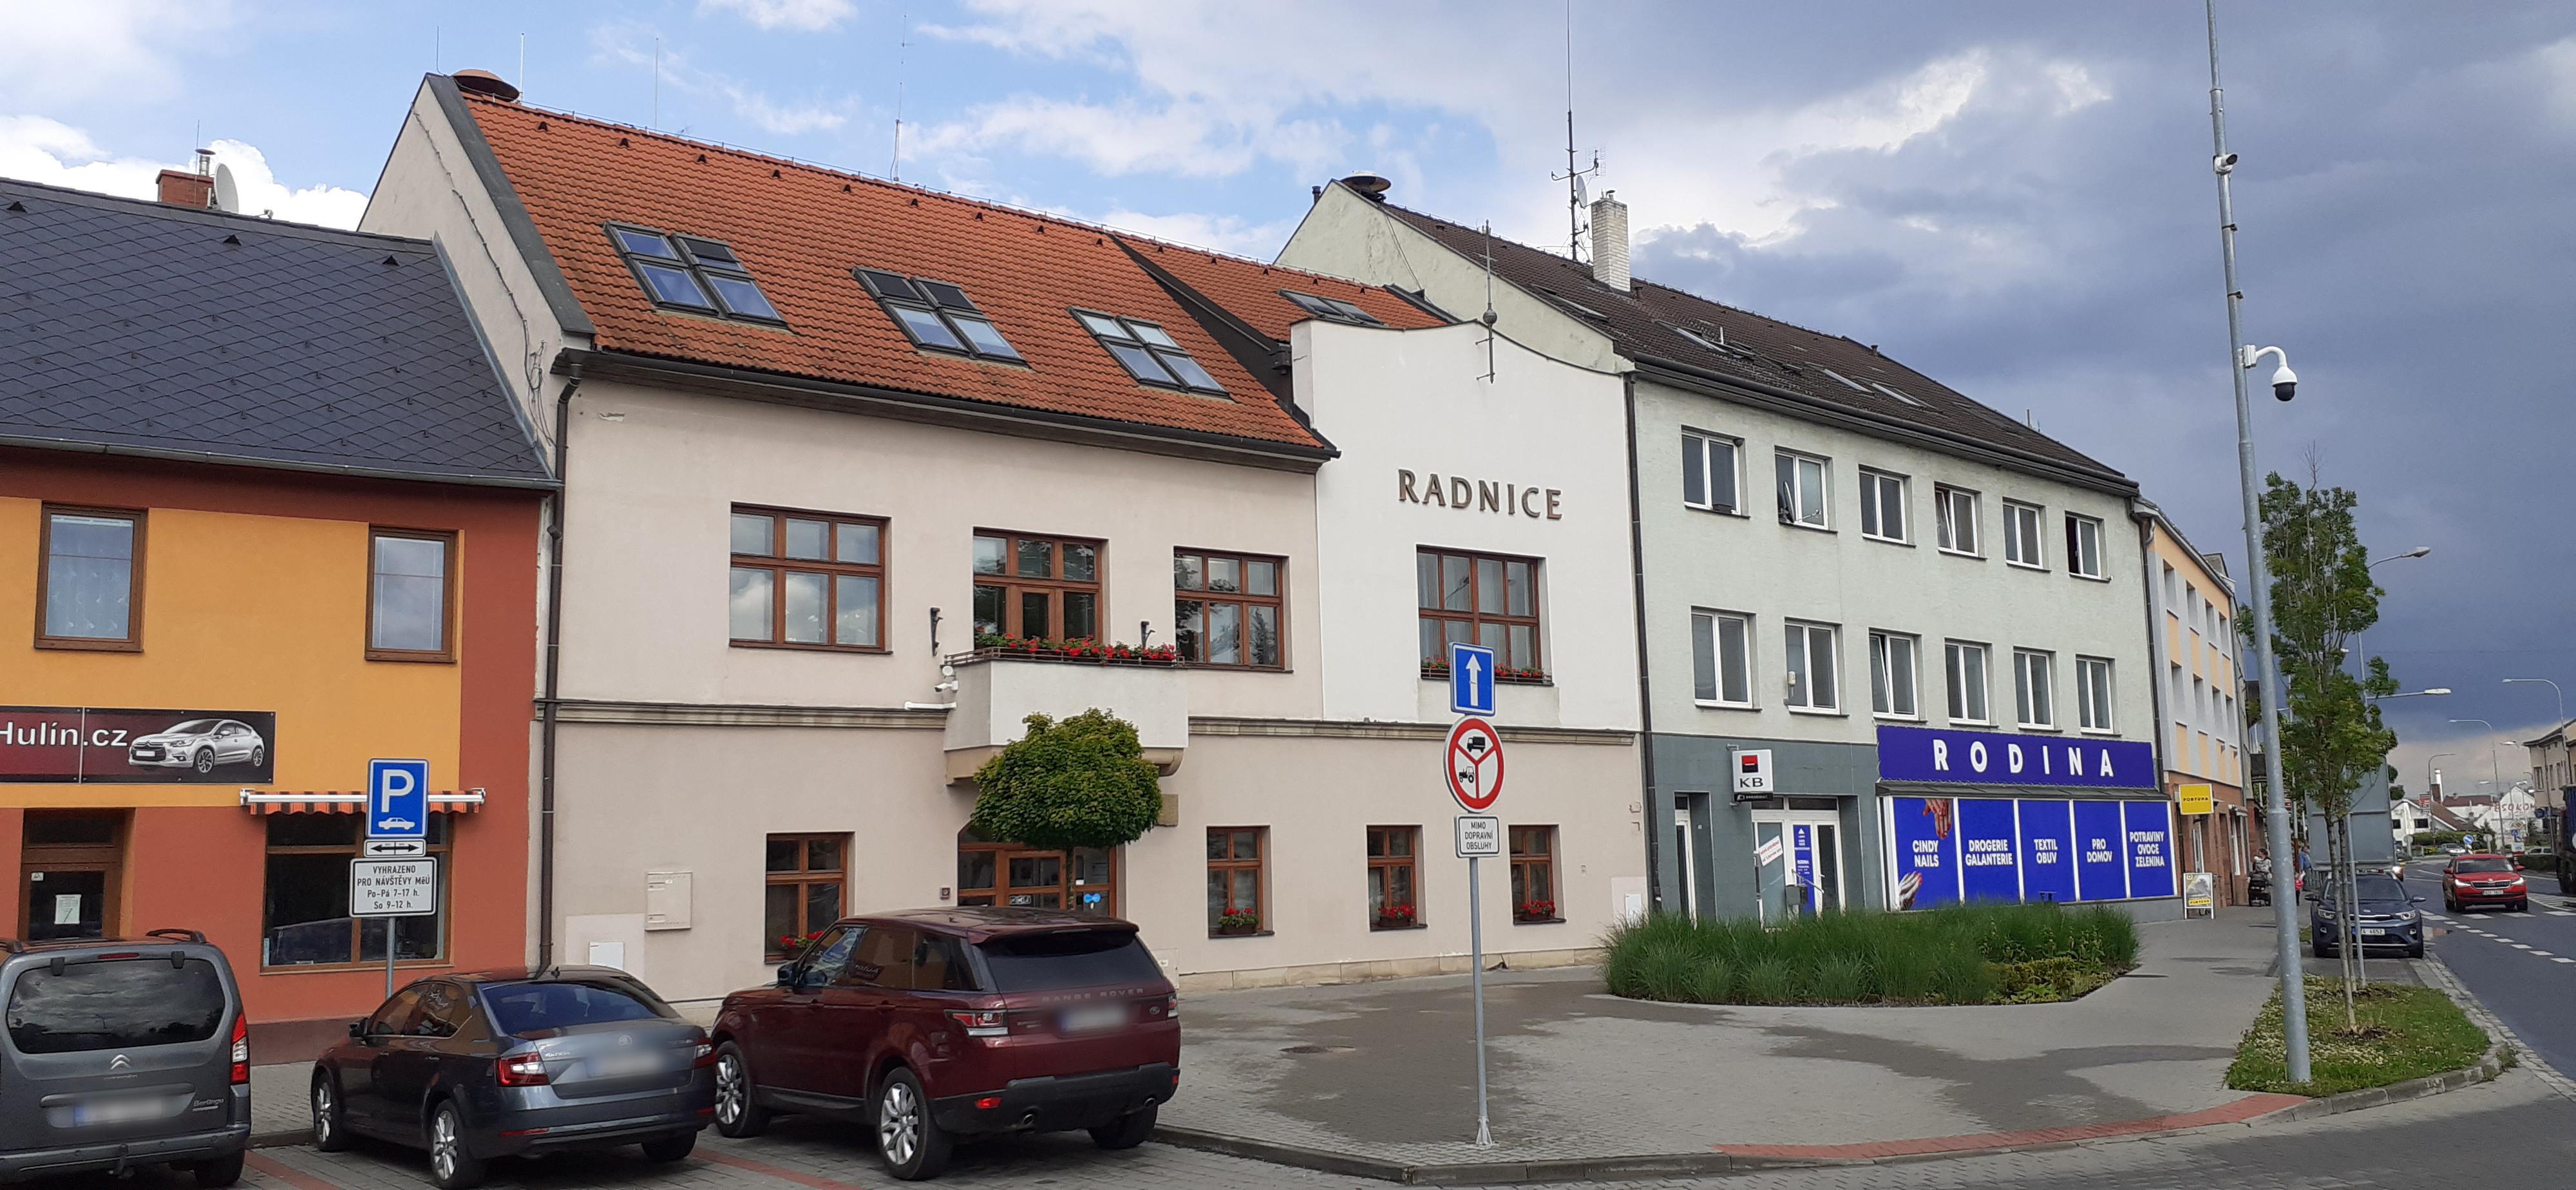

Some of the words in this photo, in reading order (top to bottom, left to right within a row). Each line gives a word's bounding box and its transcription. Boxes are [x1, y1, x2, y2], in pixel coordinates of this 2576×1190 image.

[1398, 469, 1562, 520] RADNICE
[1933, 739, 2114, 777] RODINA
[1739, 777, 1763, 788] KB
[381, 769, 415, 813] P
[1471, 821, 1486, 829] MIMO
[1464, 829, 1493, 840] DOPRAVNÍ
[2129, 831, 2164, 843] POTRAVINY
[1466, 842, 1492, 850] OBSLUHY
[1913, 839, 1938, 853] CINDY
[1969, 838, 2008, 852] DROGERIE
[2034, 838, 2058, 851] TEXTIL
[2092, 838, 2106, 850] PRO
[2137, 843, 2159, 855] OVOCE
[1914, 854, 1940, 867] NAILS
[1965, 853, 2013, 867] GALANTERIE
[2036, 851, 2058, 864] OBUV
[2086, 851, 2113, 864] DOMOV
[2135, 856, 2165, 867] ZELENINA
[373, 865, 416, 874] VYHRAZENO
[357, 878, 372, 886] PRO
[375, 874, 412, 886] NÁVŠTĚVY
[415, 874, 430, 885] MěÚ
[367, 889, 390, 898] Po-Pá
[393, 889, 410, 897] 7-17
[374, 901, 383, 909] So
[386, 900, 403, 909] 9-12
[406, 900, 413, 909] h.
[1041, 993, 1091, 1003] RANGE
[1100, 988, 1144, 997] ROVER
